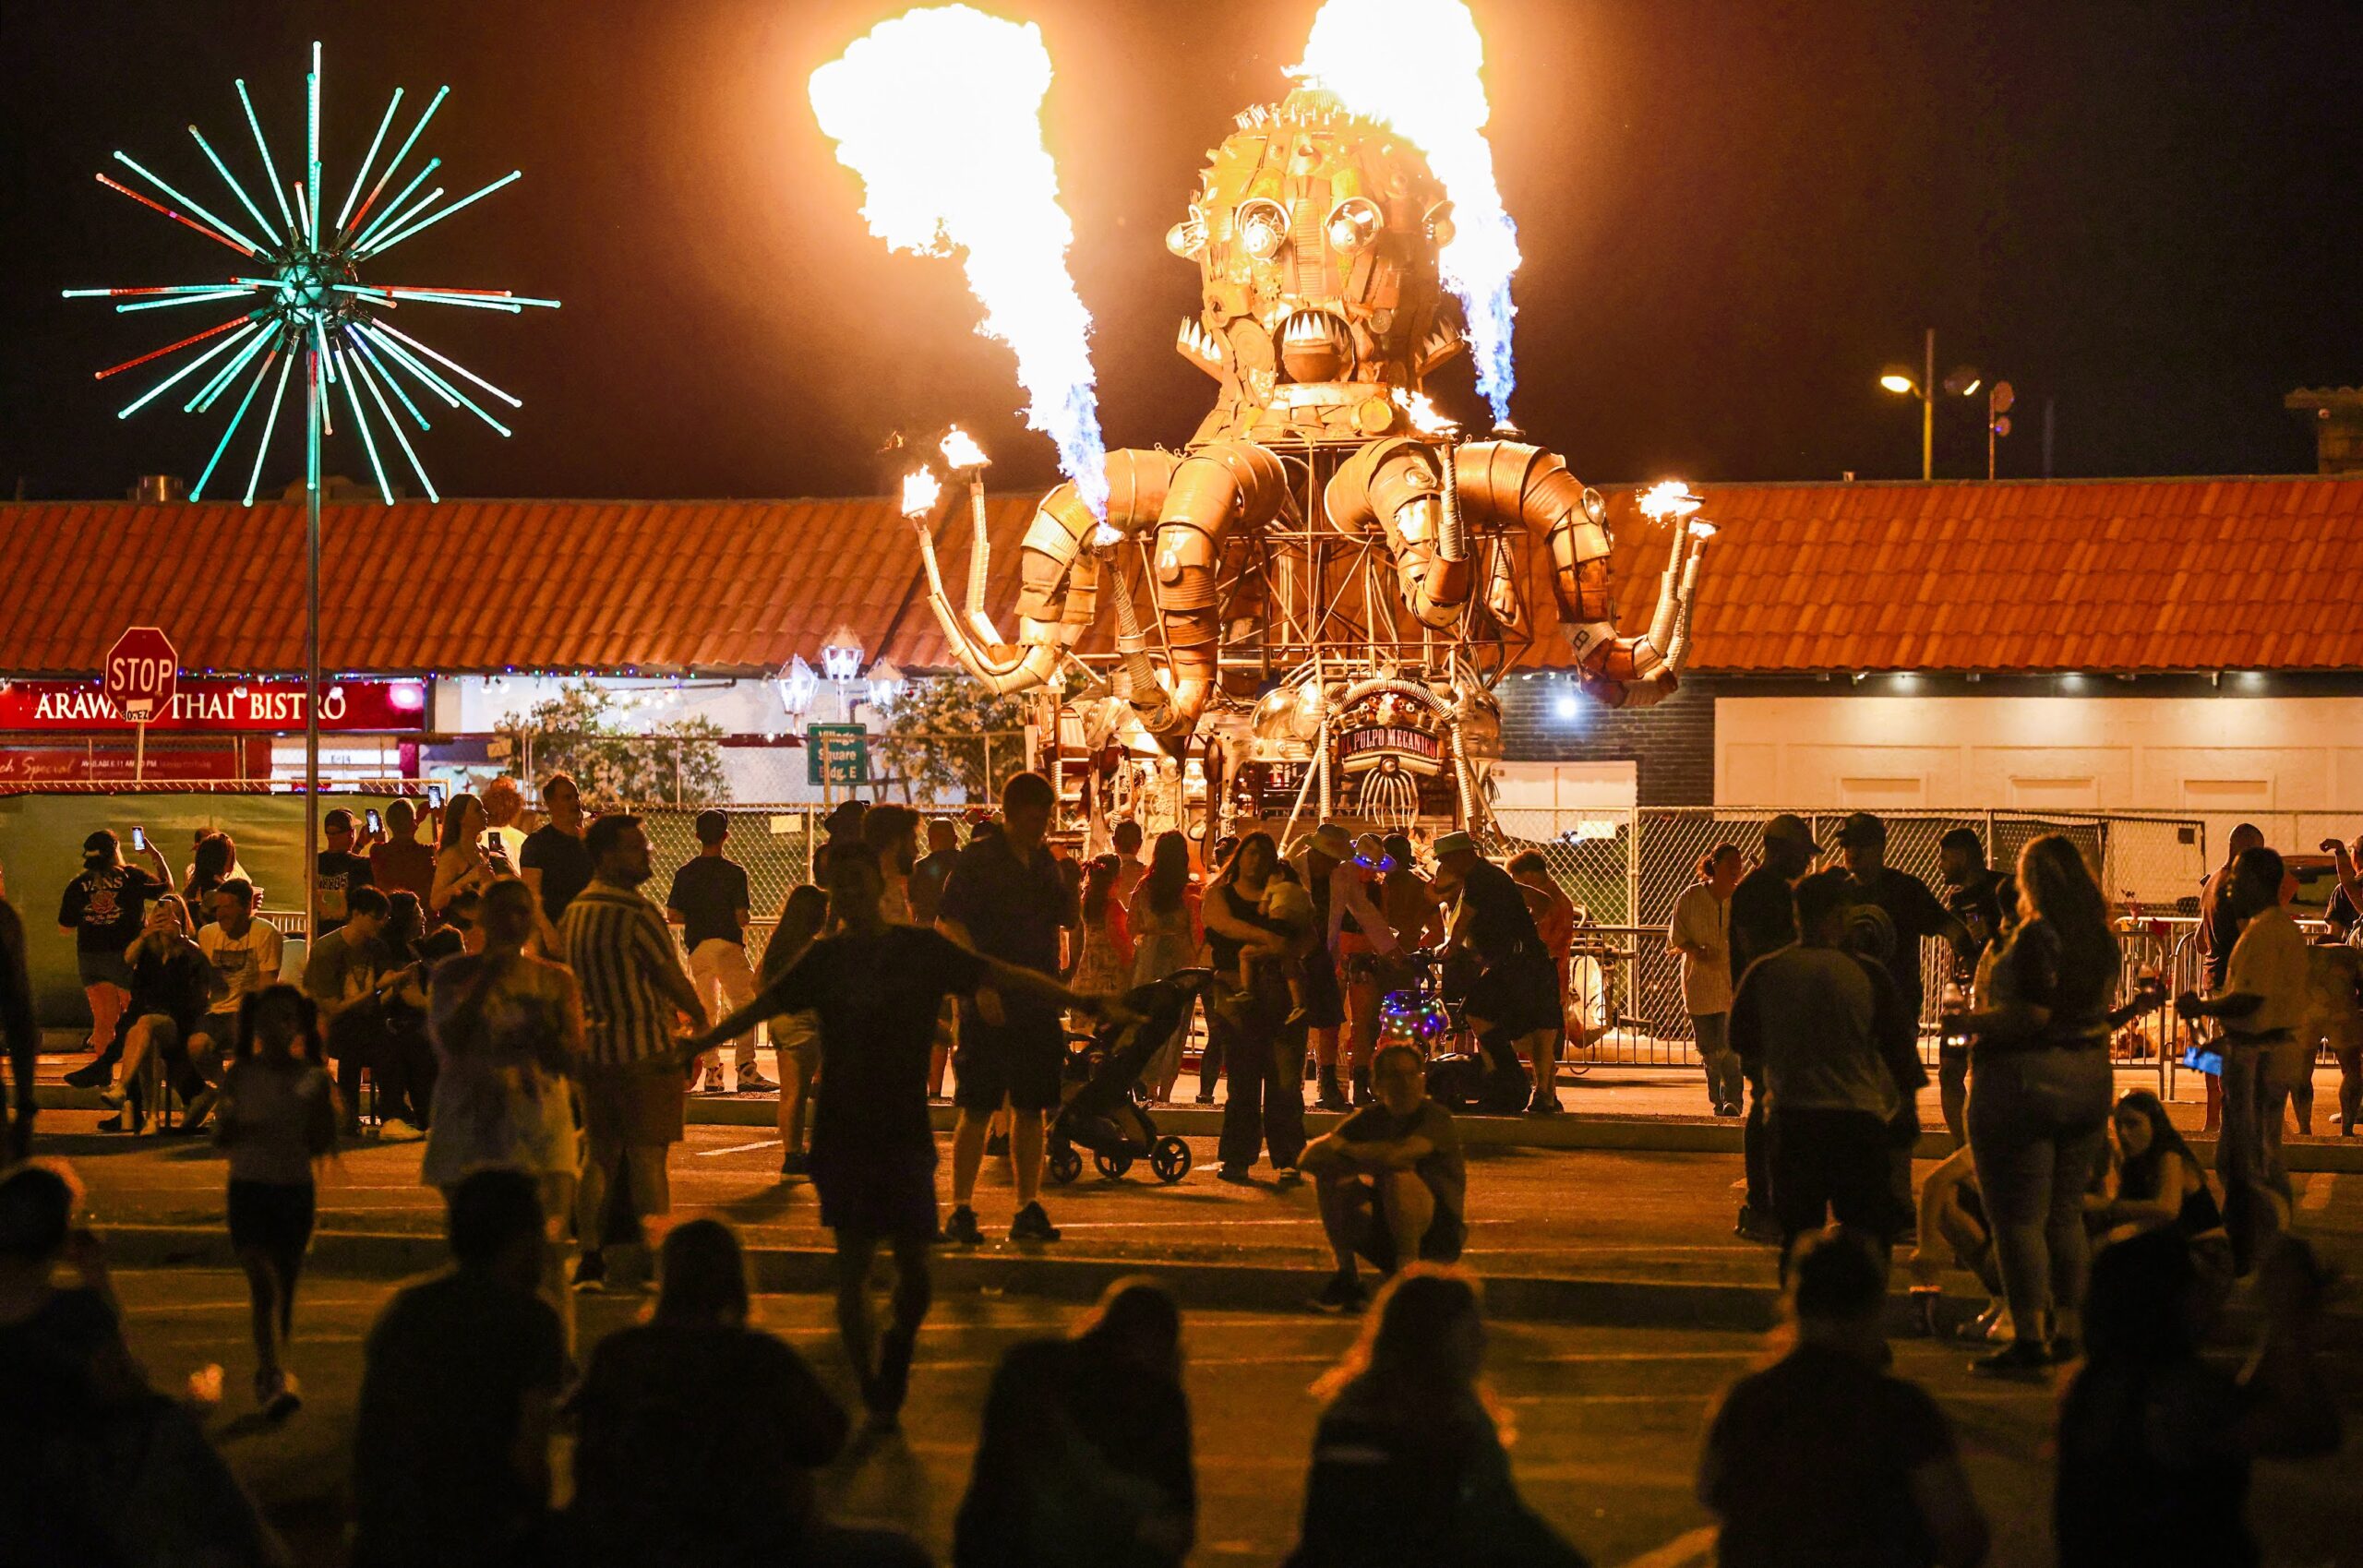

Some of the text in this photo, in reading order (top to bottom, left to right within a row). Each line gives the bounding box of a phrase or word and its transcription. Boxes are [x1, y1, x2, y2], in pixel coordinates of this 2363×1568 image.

[111, 656, 173, 692] STOP
[34, 692, 117, 720] ARAW
[172, 692, 234, 720] THAI
[818, 748, 857, 764] Square
[1341, 727, 1437, 759] EL PULPO MECANICO
[22, 756, 76, 781] Special
[819, 765, 858, 781] Bdg. E
